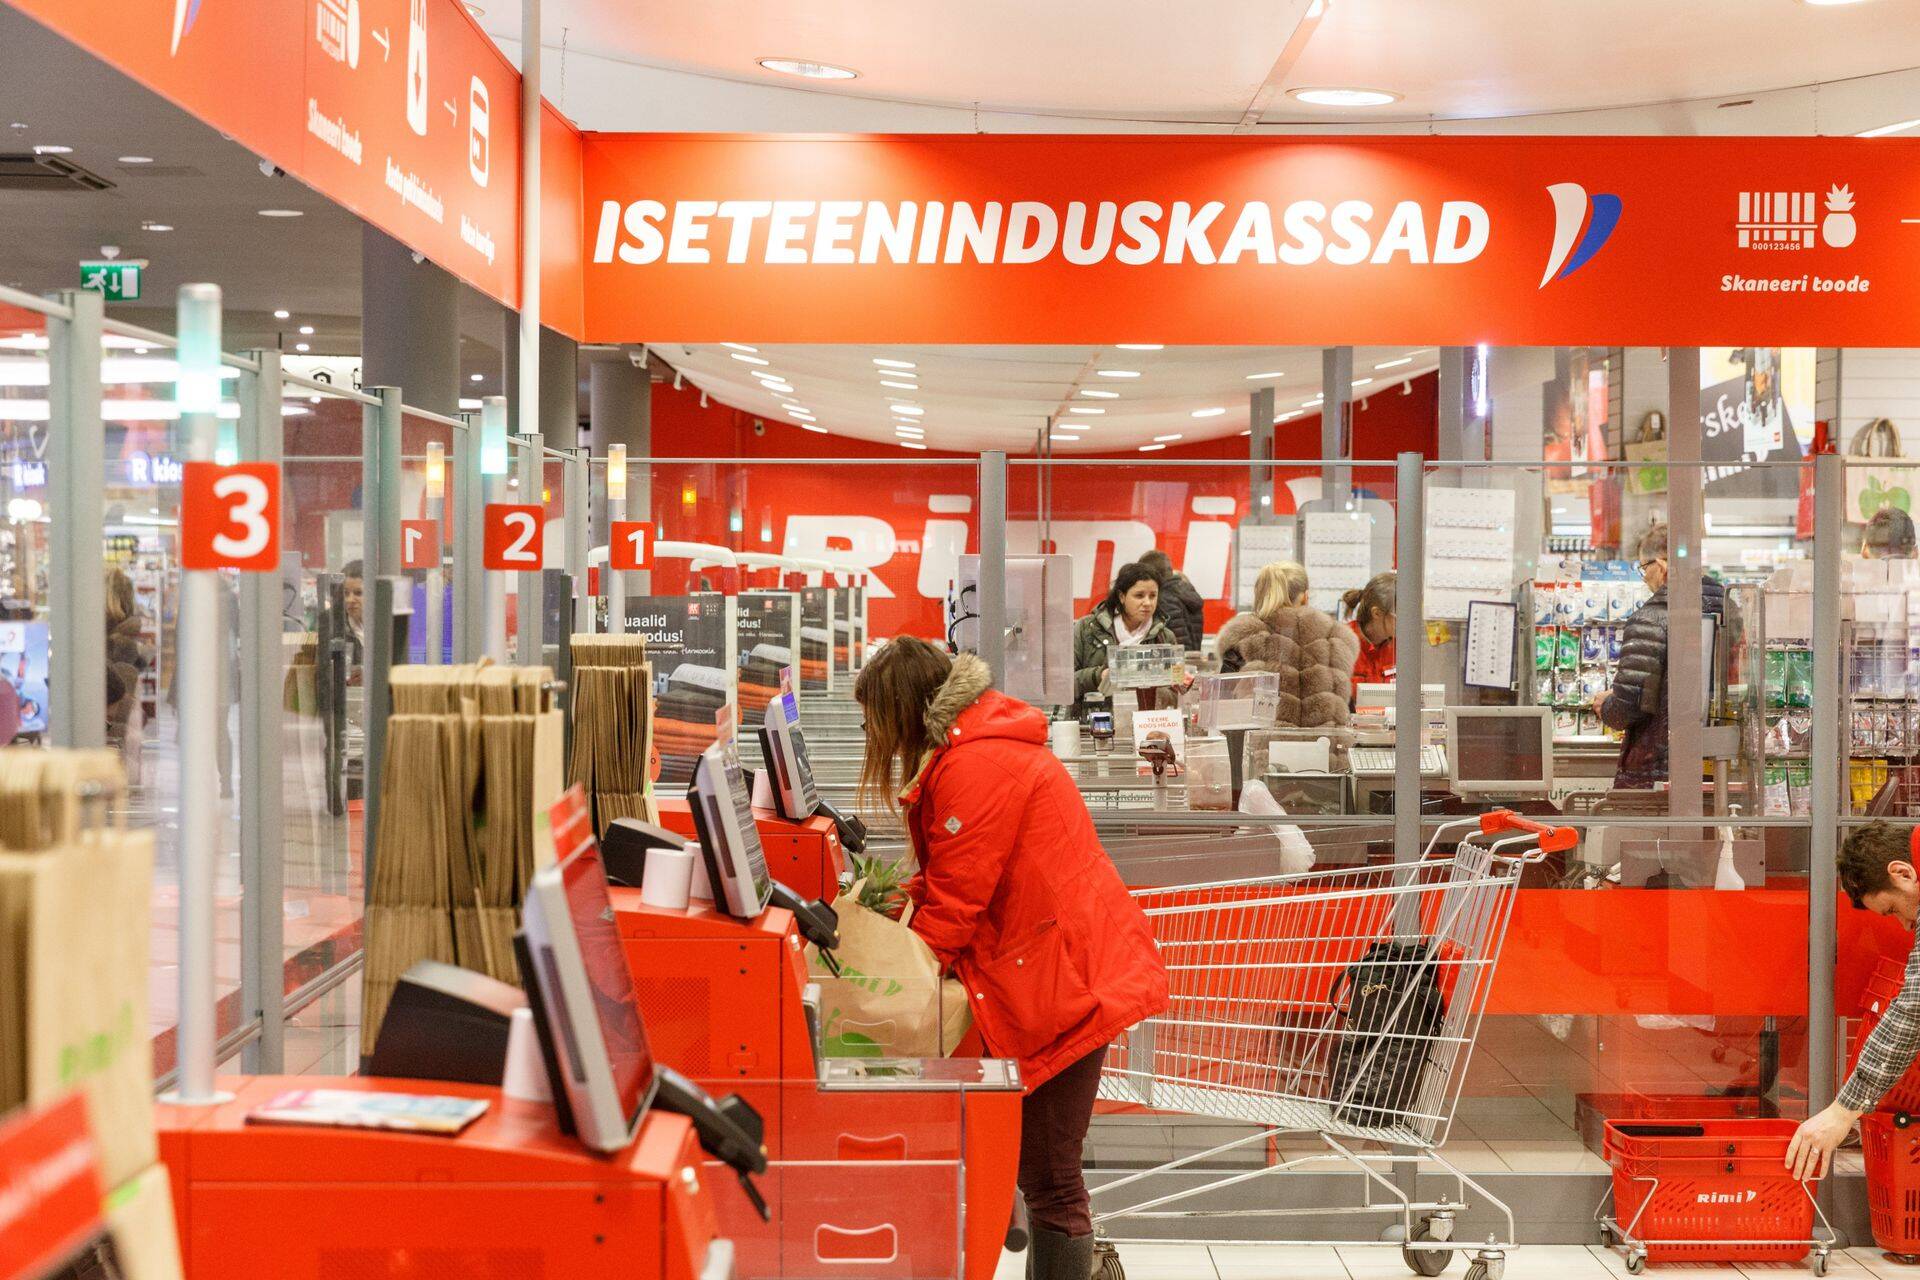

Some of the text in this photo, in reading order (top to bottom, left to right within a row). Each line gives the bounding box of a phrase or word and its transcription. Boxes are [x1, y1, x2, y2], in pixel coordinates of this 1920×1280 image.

[593, 199, 1490, 265] ISETEENINDUSKASSAD
[1720, 274, 1870, 292] Skaneeri toode
[212, 473, 270, 558] 3
[503, 512, 537, 562] 2
[627, 529, 645, 565] 1
[778, 494, 1236, 599] Rimi
[604, 614, 667, 627] uaalid
[1697, 1191, 1743, 1203] Rimi
